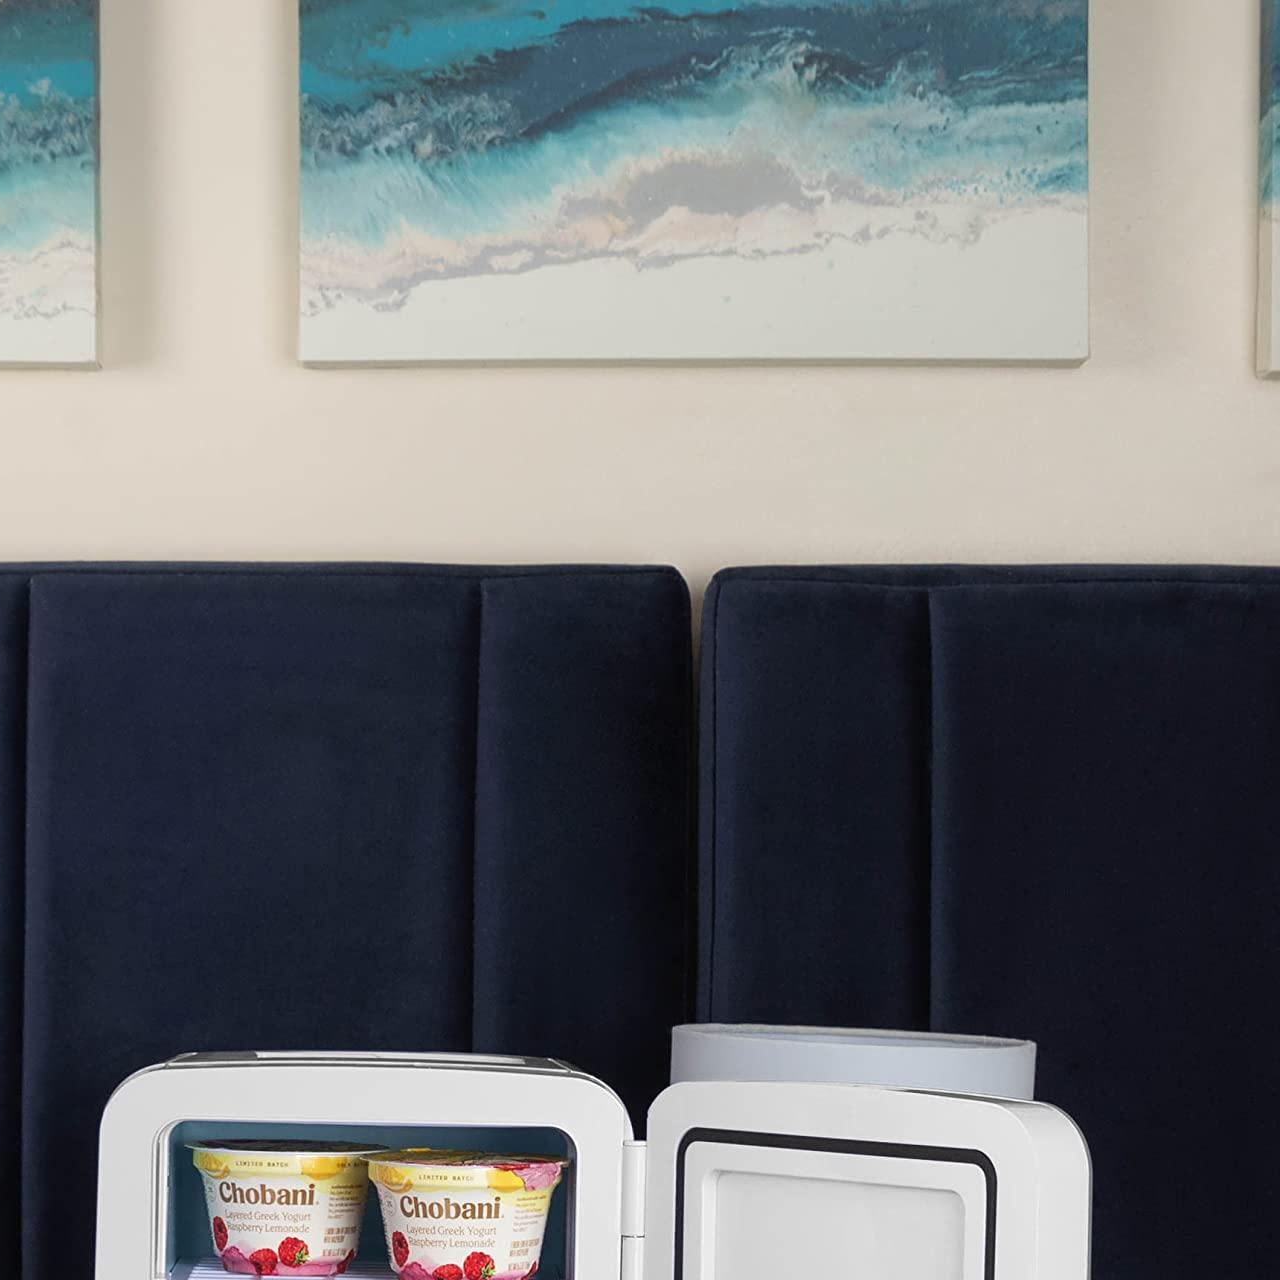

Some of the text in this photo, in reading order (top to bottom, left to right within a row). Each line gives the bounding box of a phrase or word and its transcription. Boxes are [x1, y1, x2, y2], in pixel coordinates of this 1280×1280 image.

[219, 1181, 315, 1206] Chobani
[400, 1195, 501, 1220] Chobani
[225, 1210, 311, 1222] Layered Greek Yogurt
[226, 1222, 310, 1234] Raspberry Lemonade
[407, 1224, 497, 1238] Layered Greek Yogurt
[409, 1237, 496, 1249] Raspberry Lemonade
